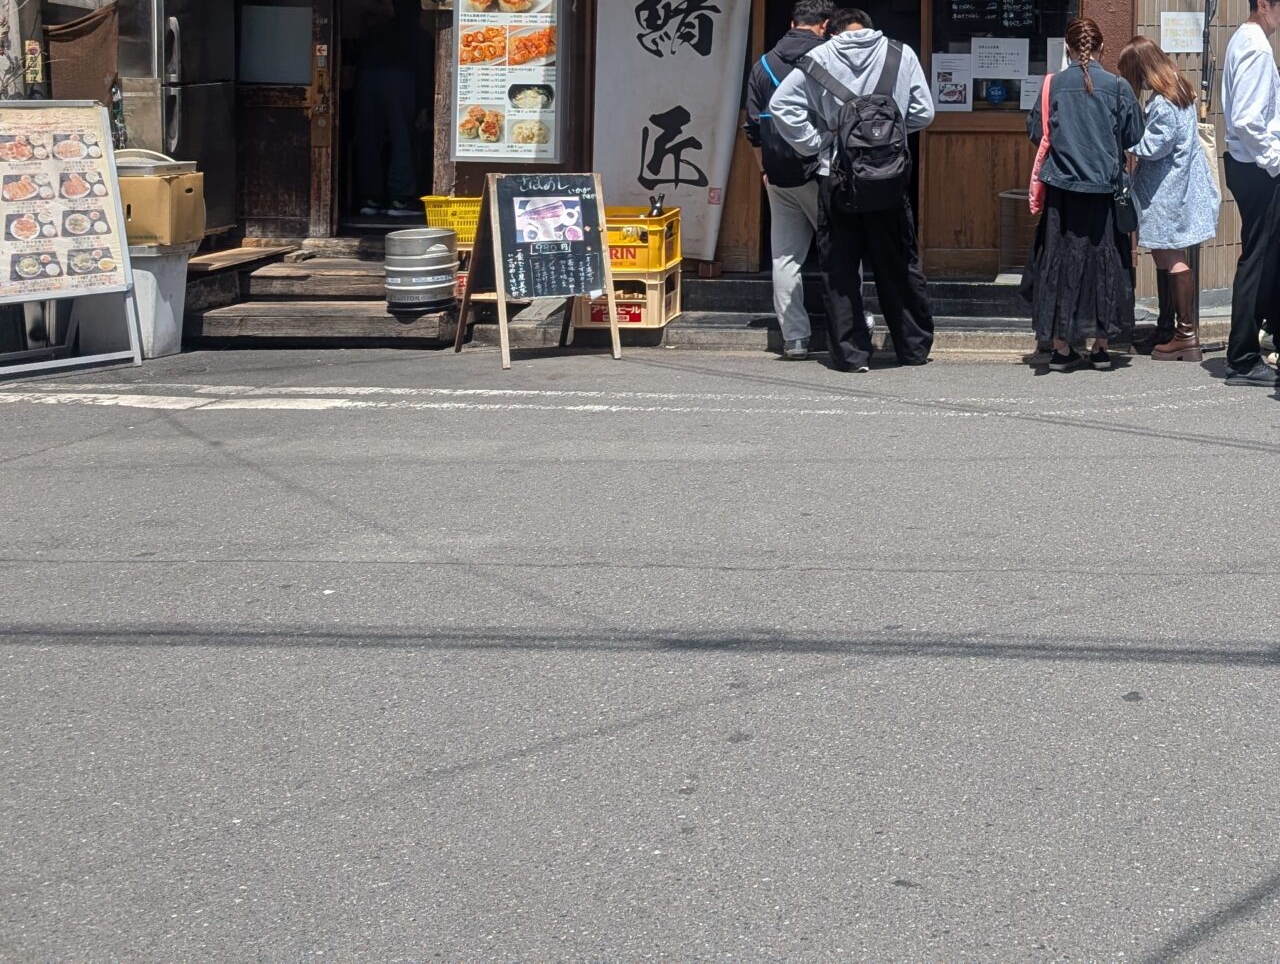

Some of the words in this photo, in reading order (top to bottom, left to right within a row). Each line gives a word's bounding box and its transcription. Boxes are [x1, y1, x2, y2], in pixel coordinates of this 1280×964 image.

[591, 305, 641, 314] アサビール
